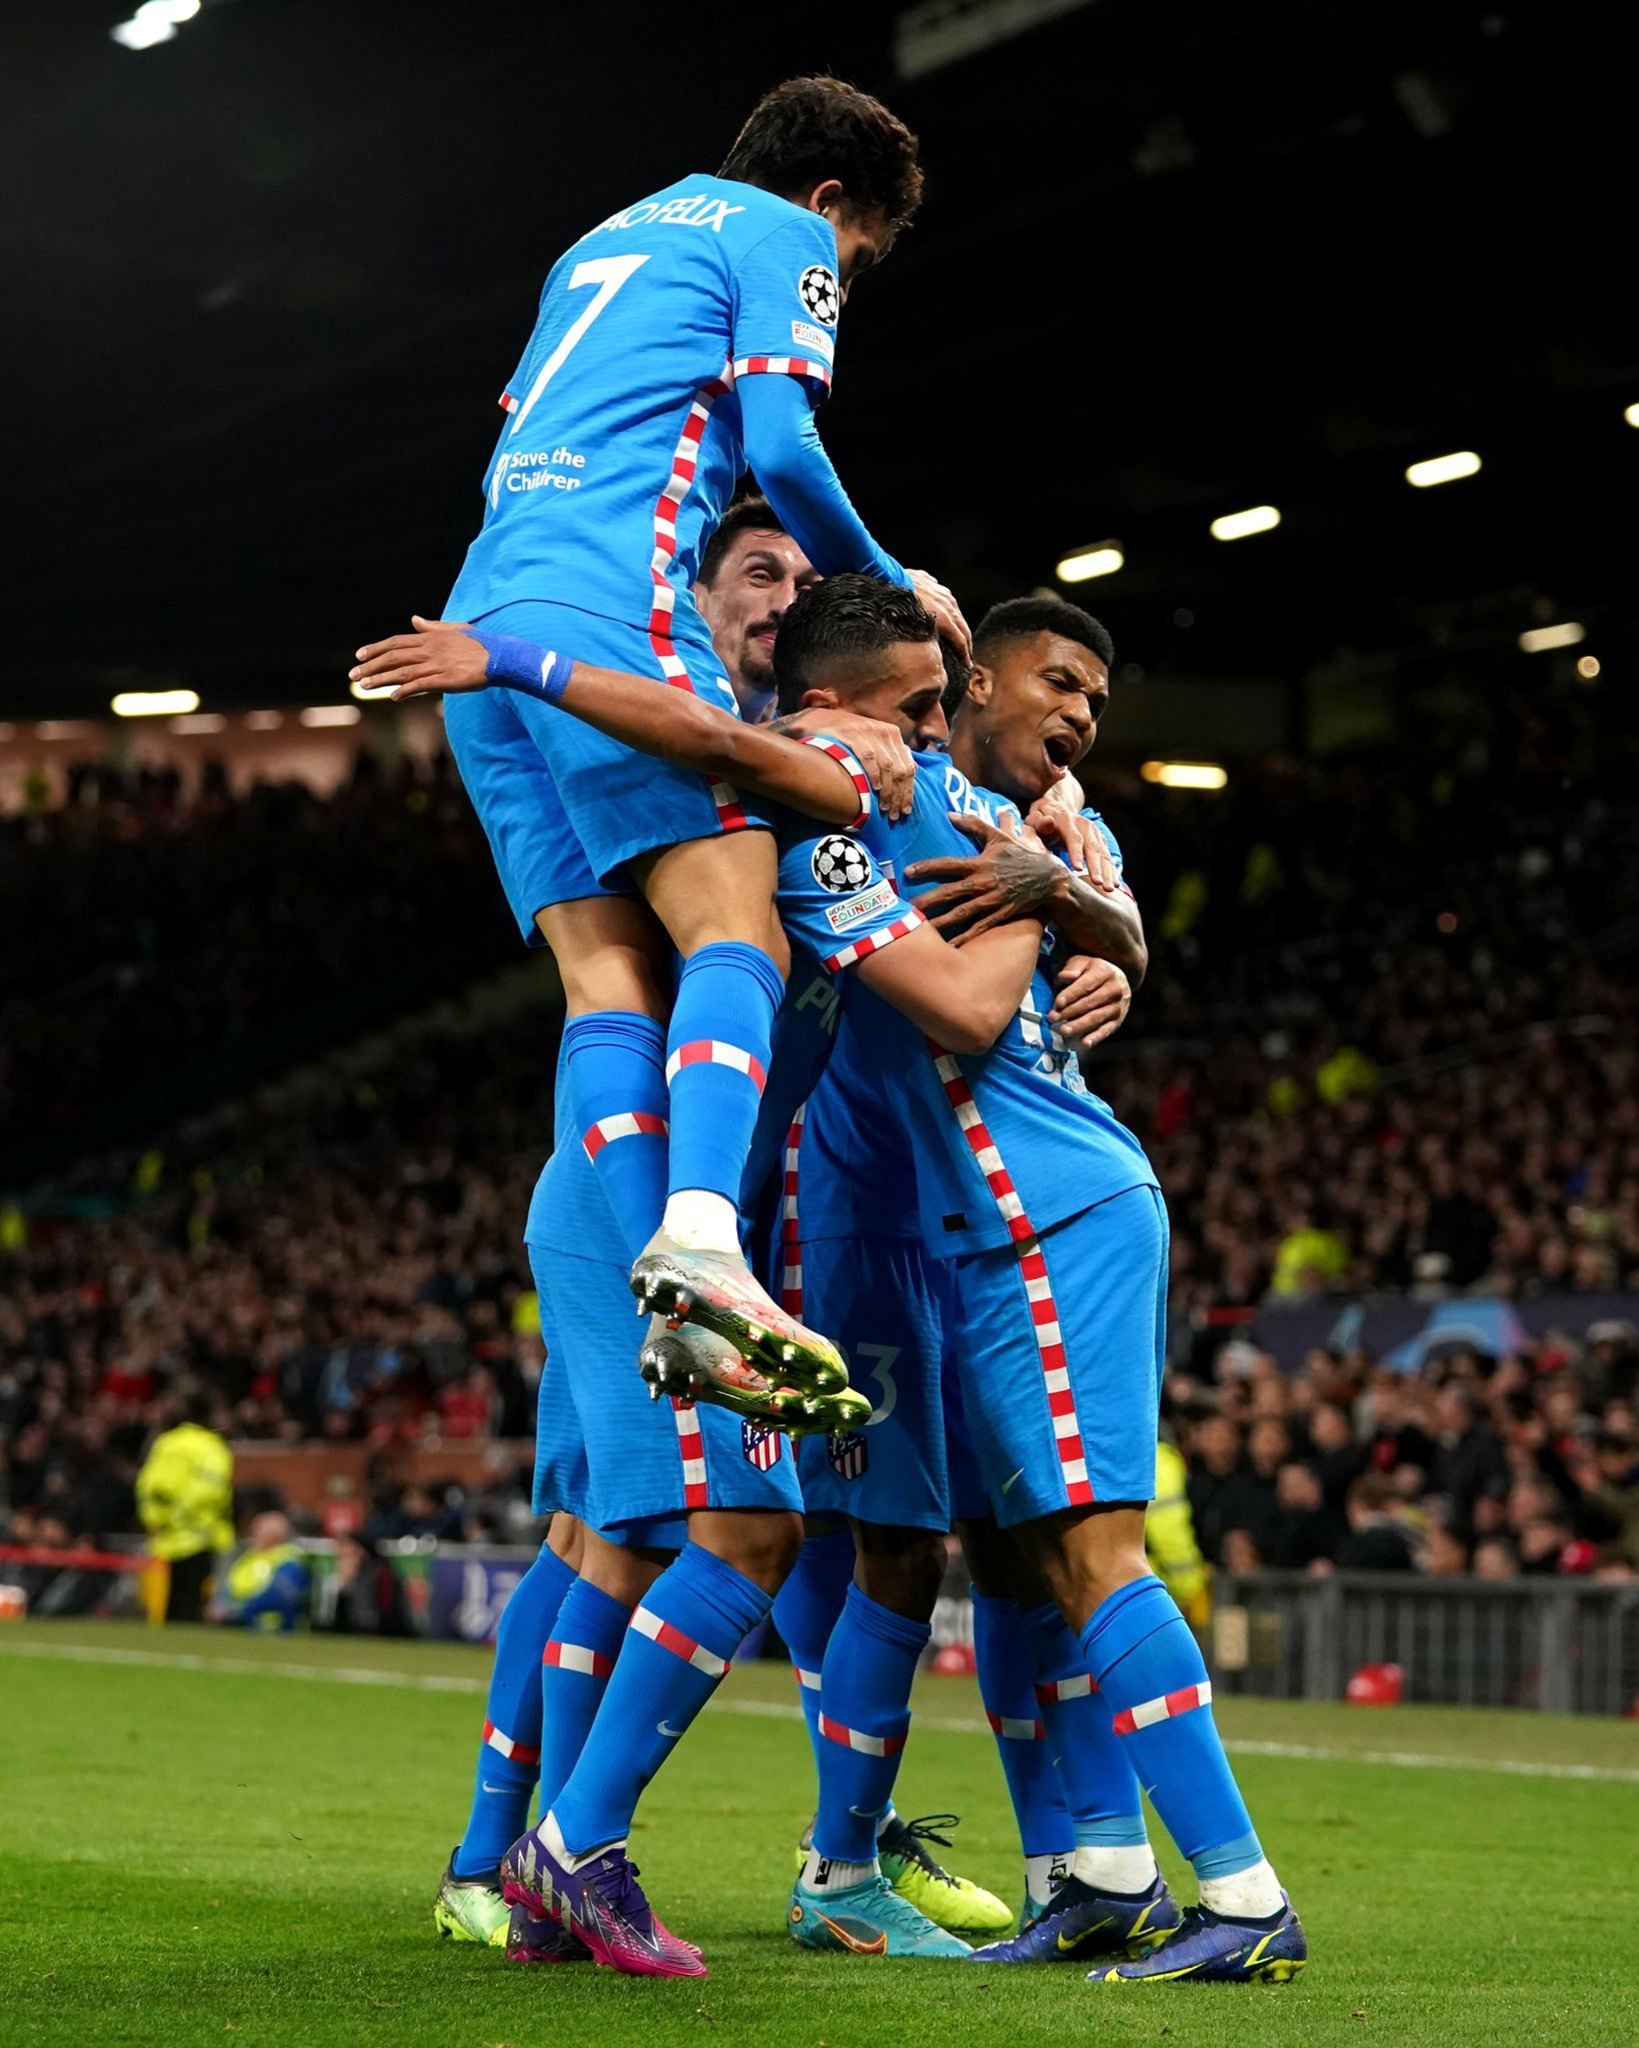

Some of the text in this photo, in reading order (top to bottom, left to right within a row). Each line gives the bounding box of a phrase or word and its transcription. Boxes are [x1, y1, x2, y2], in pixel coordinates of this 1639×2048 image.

[510, 254, 653, 435] 7
[509, 446, 586, 469] Save the
